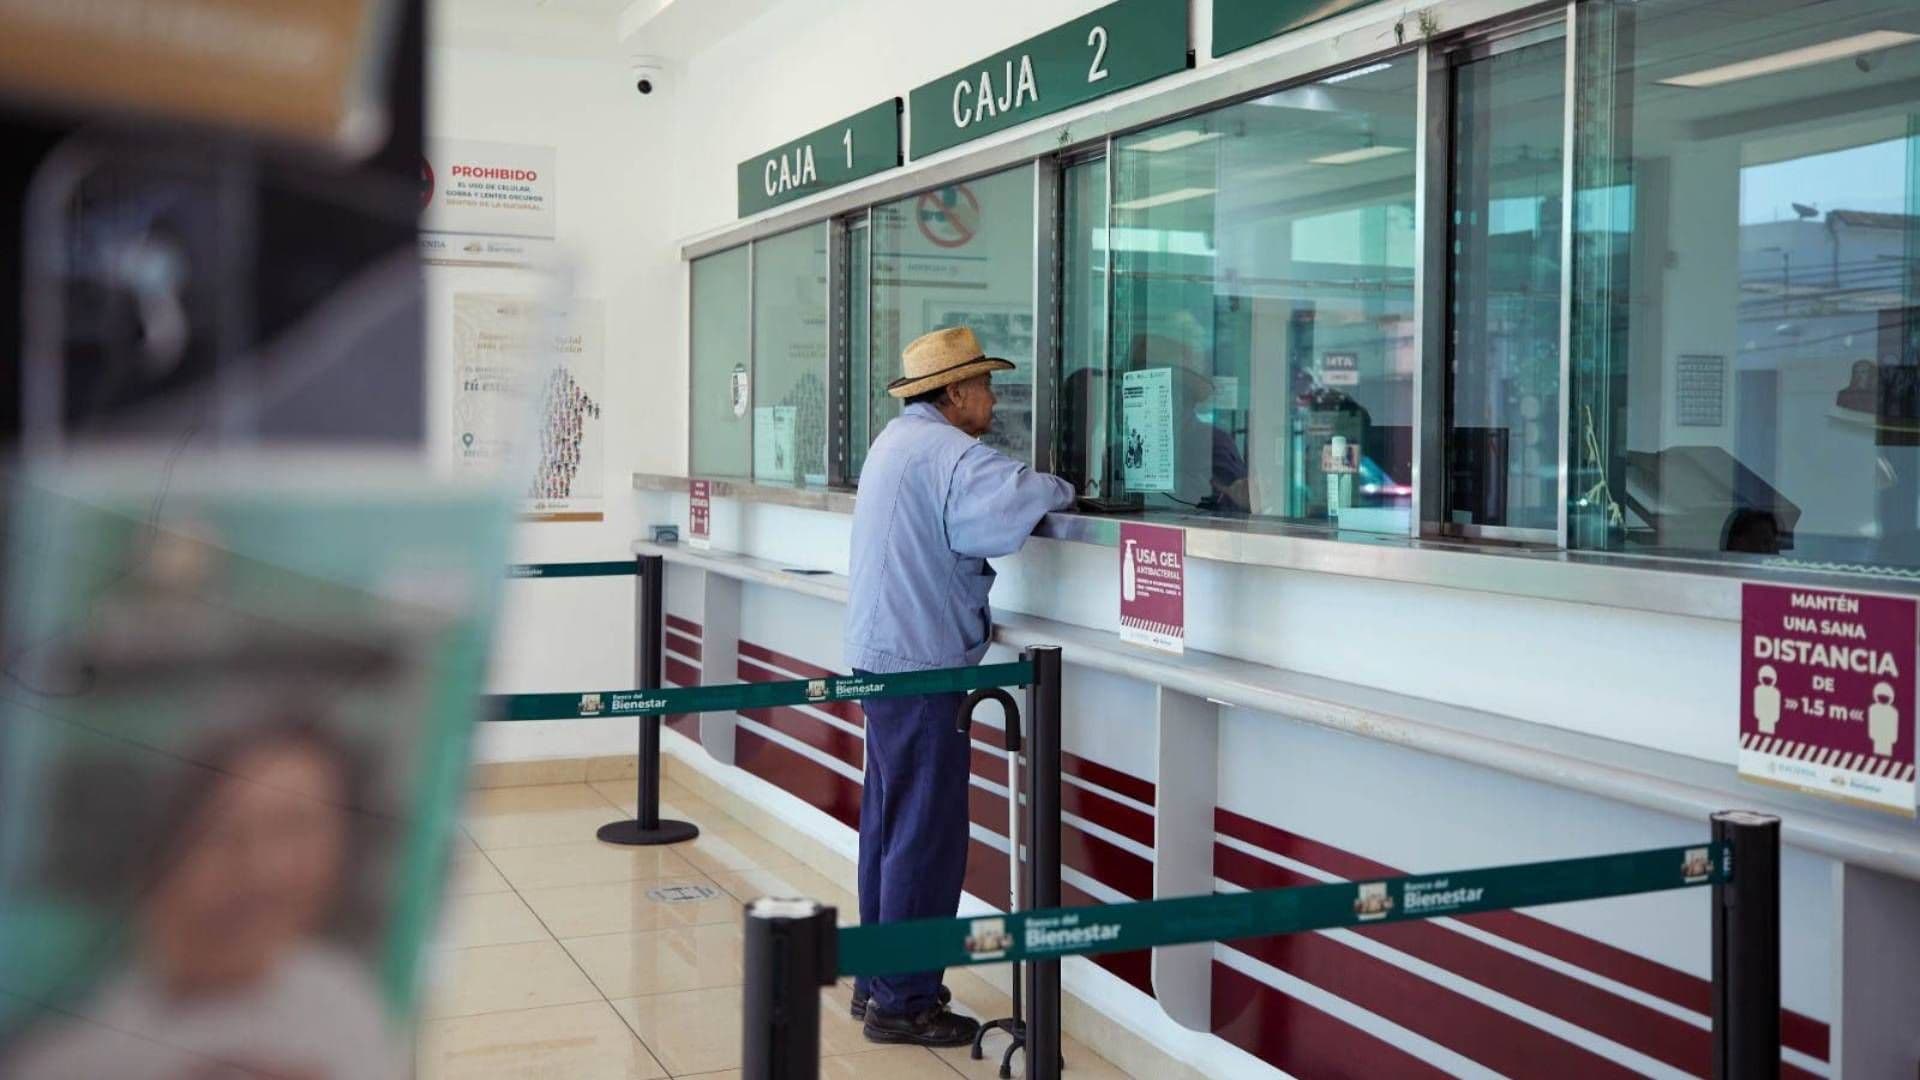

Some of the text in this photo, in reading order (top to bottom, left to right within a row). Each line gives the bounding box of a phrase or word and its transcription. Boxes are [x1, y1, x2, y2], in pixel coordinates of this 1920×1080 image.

[953, 26, 1109, 128] CAJA 2
[764, 129, 854, 197] CAJA 1
[452, 166, 537, 181] PROHIBIDO
[509, 194, 543, 202] OSCUROS
[1136, 548, 1181, 569] USA GEL
[1136, 566, 1181, 580] ANTIBACTERIAL
[1791, 593, 1859, 613] MANTÉN
[1783, 616, 1866, 639] UNA SANA
[1754, 635, 1898, 678] DISTANCIA
[836, 682, 885, 695] Bienestar
[1812, 676, 1834, 692] DE
[612, 698, 667, 710] Bienestar
[1801, 697, 1848, 721] 1.5 m
[1404, 888, 1484, 908] Bienestar
[1025, 923, 1121, 947] Bienestar
